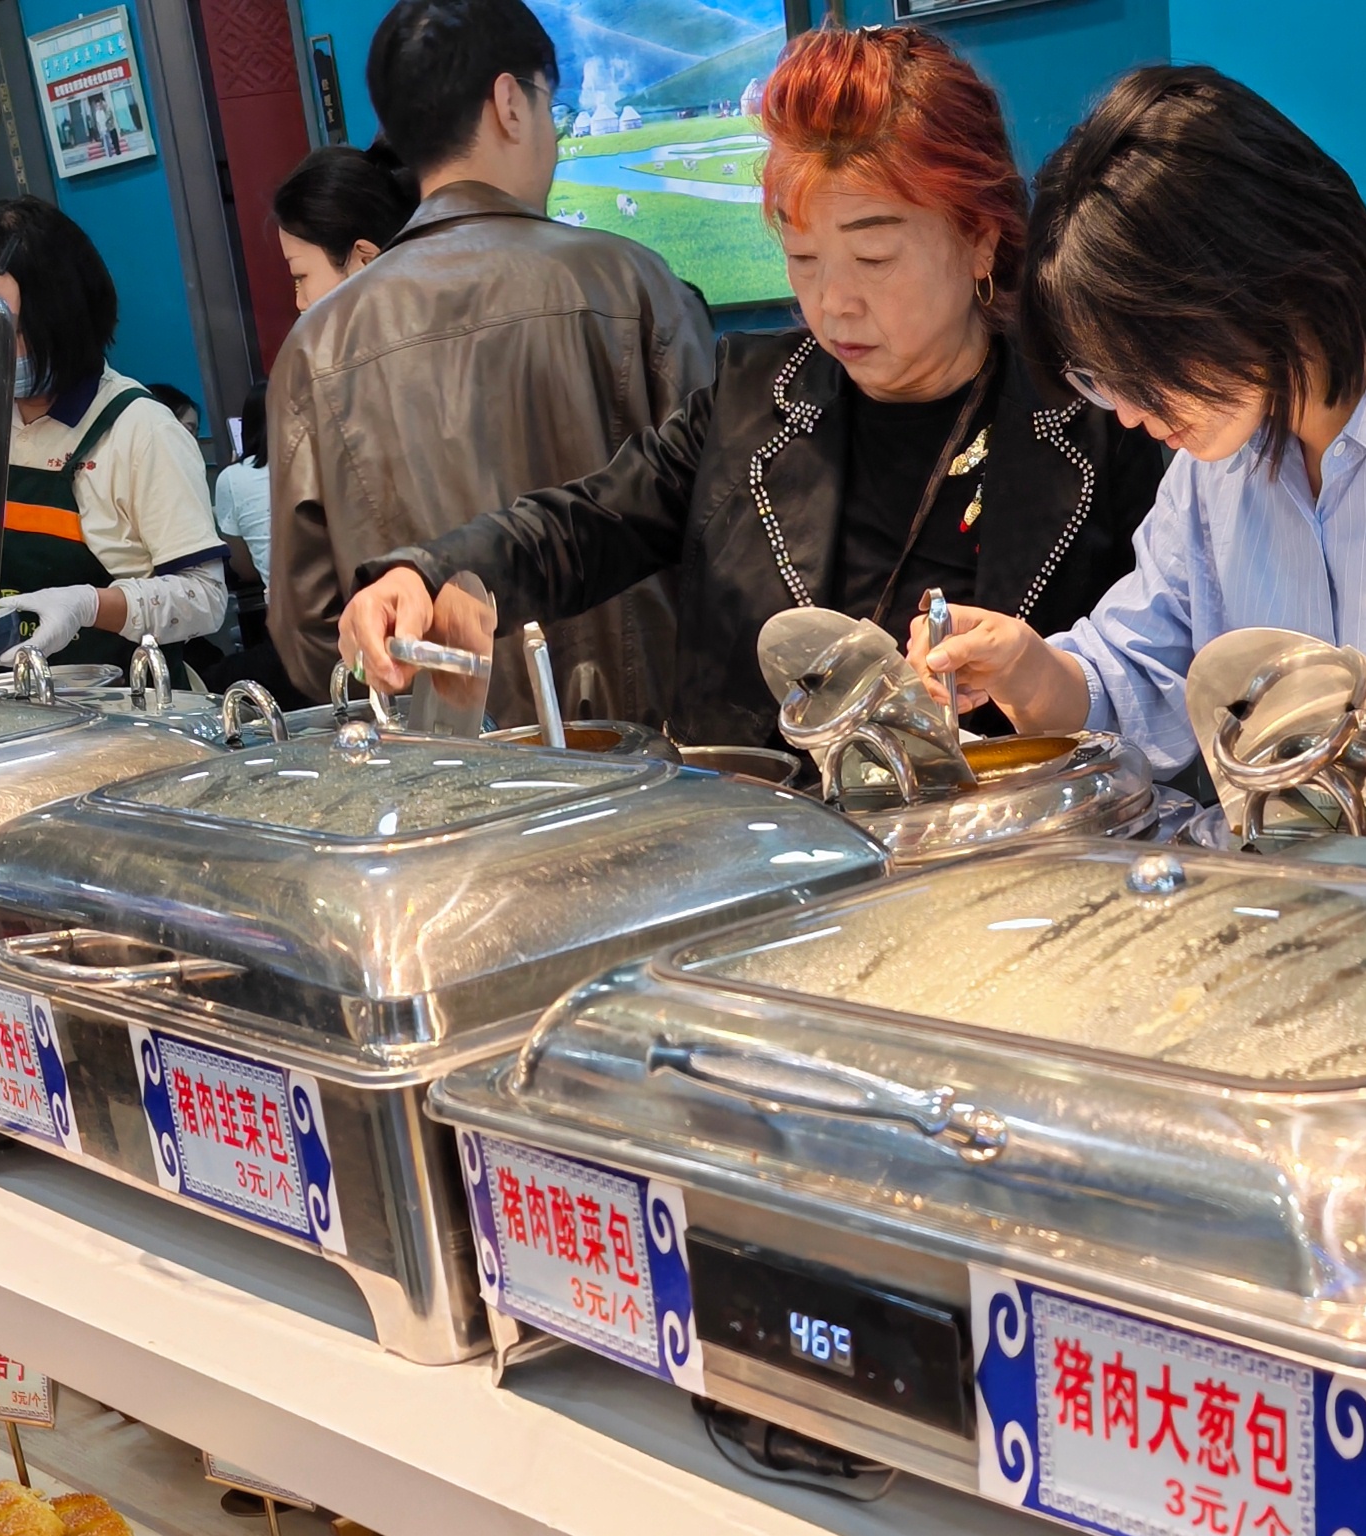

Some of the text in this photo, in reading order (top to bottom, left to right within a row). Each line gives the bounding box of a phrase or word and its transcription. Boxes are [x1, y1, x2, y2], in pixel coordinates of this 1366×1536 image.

[0, 1076, 42, 1115] 3元/个
[173, 1067, 289, 1164] 猪肉韭菜包
[236, 1160, 294, 1208] 3元/个
[497, 1166, 639, 1287] 猪肉酸菜包
[571, 1277, 644, 1334] 3元/个
[11, 1390, 42, 1407] 3元/个
[1054, 1336, 1293, 1496] 猪肉大葱包
